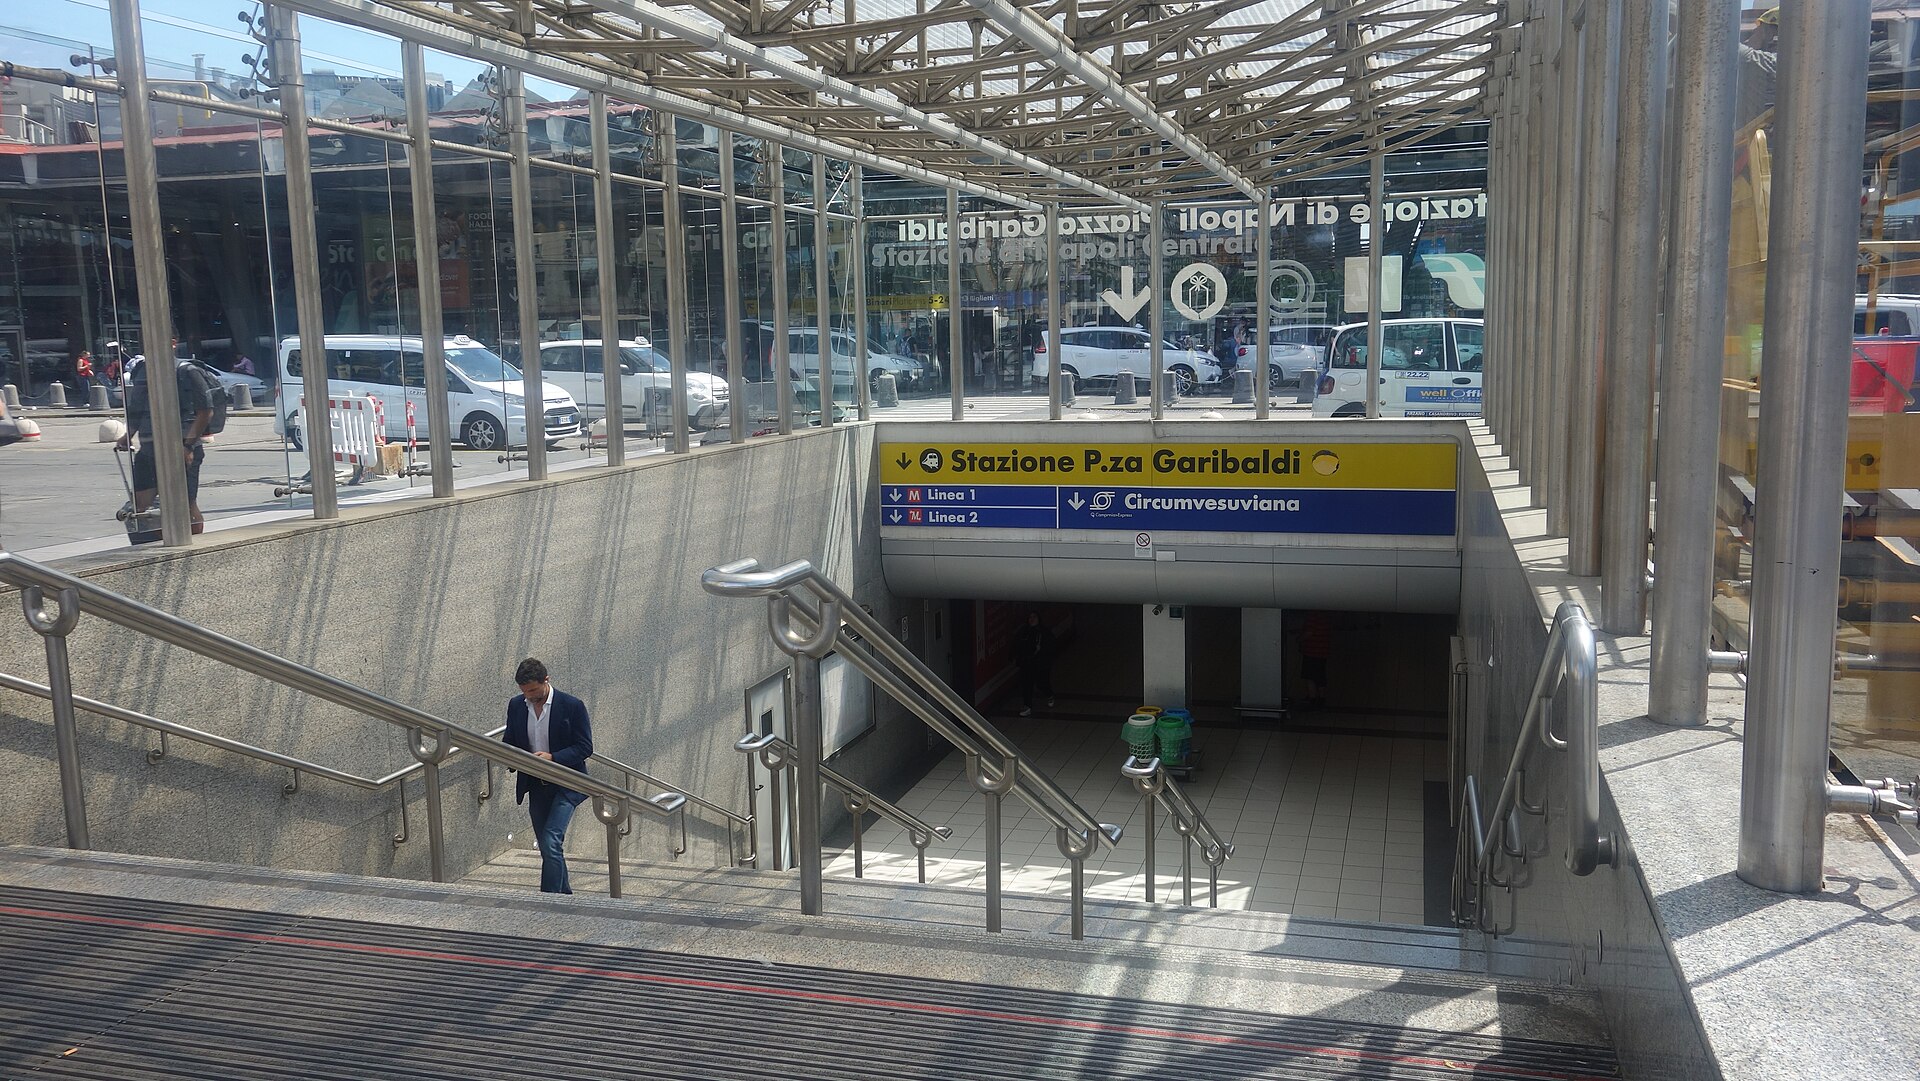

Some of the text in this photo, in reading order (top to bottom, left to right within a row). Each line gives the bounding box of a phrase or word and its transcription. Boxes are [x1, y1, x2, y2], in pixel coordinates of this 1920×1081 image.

[871, 241, 992, 267] Stazione
[1420, 389, 1447, 397] well
[1451, 389, 1482, 398] Offi
[951, 448, 1301, 474] Stazione P.za Garibaldi
[927, 488, 965, 501] Linea
[969, 488, 976, 500] 1
[1123, 491, 1300, 513] Circumvesuviana
[928, 510, 966, 523] Linea
[969, 510, 979, 523] 2
